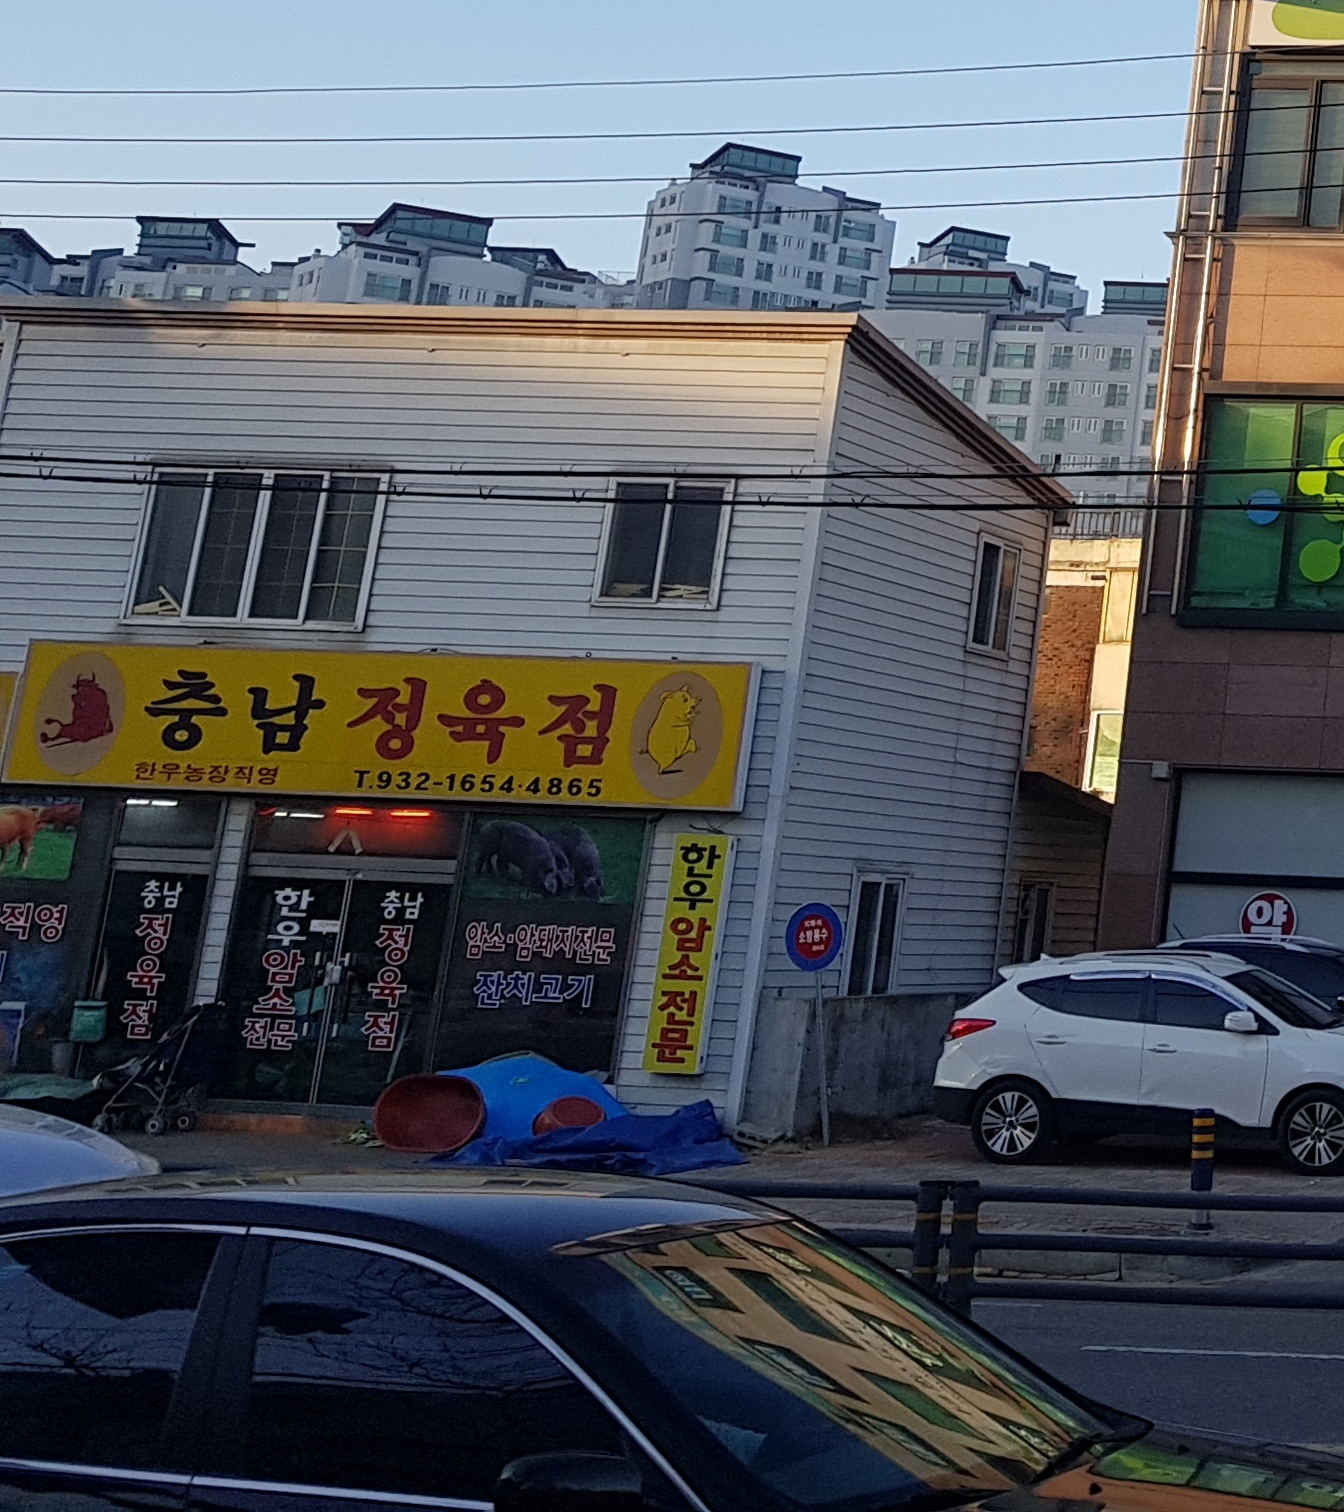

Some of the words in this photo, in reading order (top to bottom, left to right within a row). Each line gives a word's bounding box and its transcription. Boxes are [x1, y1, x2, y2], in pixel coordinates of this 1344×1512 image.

[143, 668, 327, 757] 충남
[346, 675, 621, 770] 정육점
[134, 760, 280, 787] 한우농장직영
[140, 879, 183, 909] 충남
[672, 841, 722, 913] 한우
[0, 901, 68, 943] 직영
[266, 887, 314, 946] 한우
[380, 890, 424, 920] 충남
[1246, 899, 1289, 942] 약
[120, 913, 173, 1040] 정육점
[252, 949, 306, 1015] 암소
[361, 924, 414, 1052] 정육점
[473, 970, 595, 1009] 잔치고기
[241, 1018, 300, 1051] 전문
